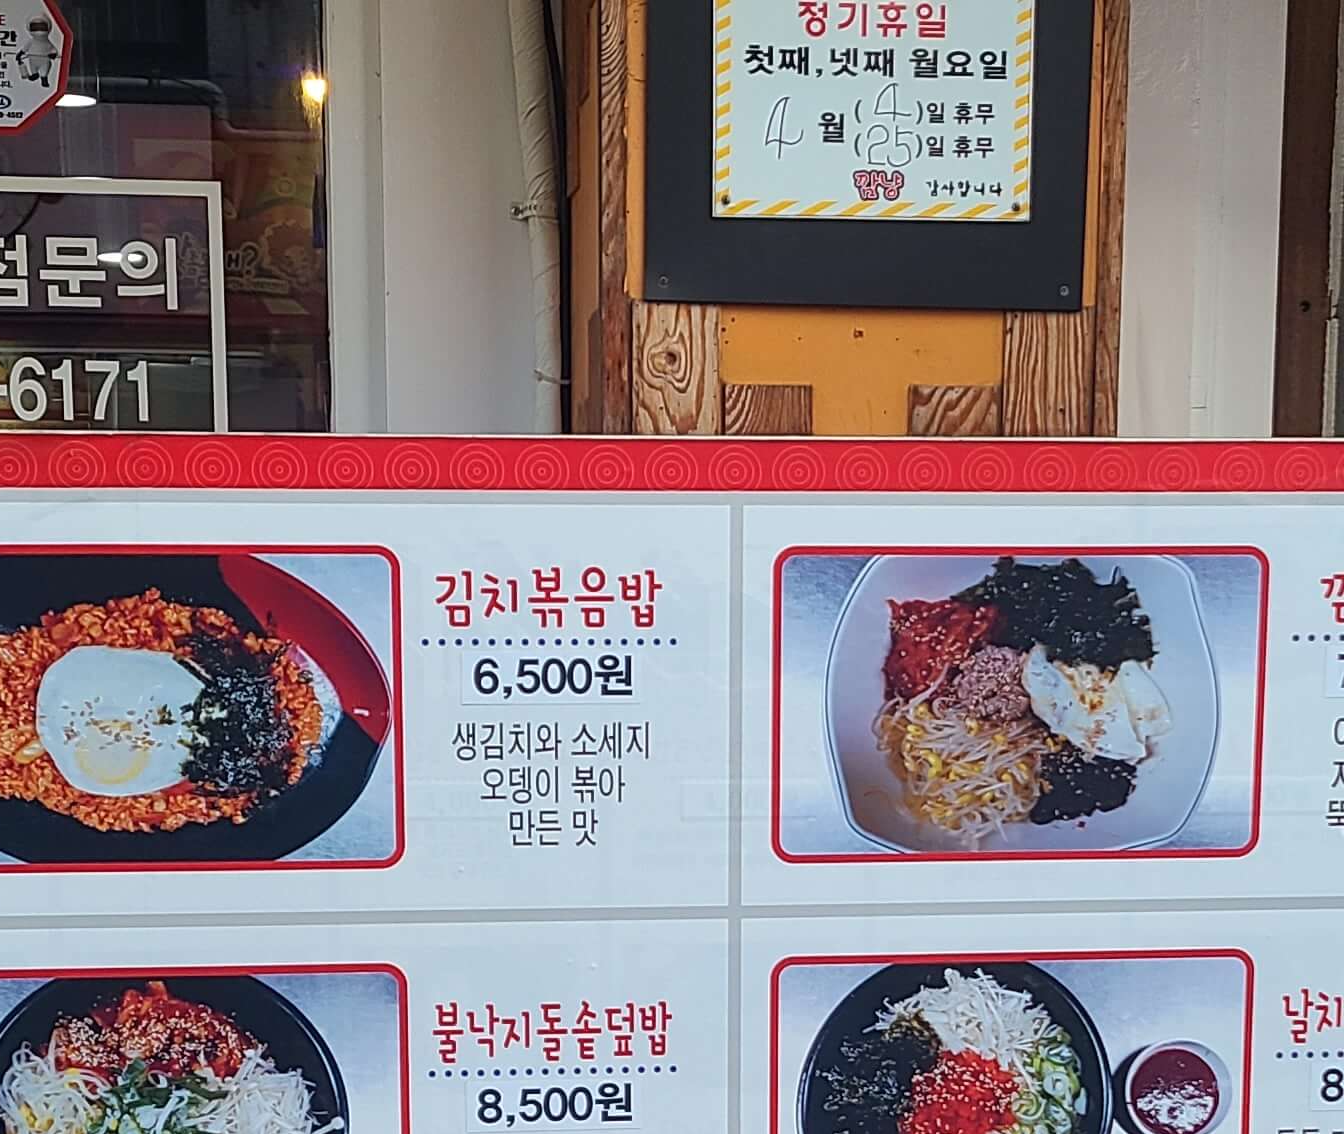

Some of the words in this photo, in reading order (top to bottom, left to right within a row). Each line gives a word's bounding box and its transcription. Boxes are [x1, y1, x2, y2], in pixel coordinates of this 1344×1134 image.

[798, 0, 946, 38] 정기휴일
[908, 48, 1008, 80] 월요일
[818, 111, 845, 143] 월
[953, 102, 995, 125] 휴무
[952, 135, 994, 158] 휴무
[852, 169, 905, 200] 깜냥
[924, 179, 1003, 197] 감사합니다
[434, 565, 664, 629] 김치볶음밥
[472, 654, 634, 700] 6,500원
[451, 721, 563, 762] 생김치와
[570, 721, 651, 761] 소세지
[480, 765, 559, 804] 오뎅이
[570, 765, 626, 804] 볶아
[508, 810, 562, 847] 만든
[572, 809, 599, 847] 맛
[431, 1000, 674, 1065] 불낙지돌솥덮밥
[476, 1082, 634, 1128] 8,500원
